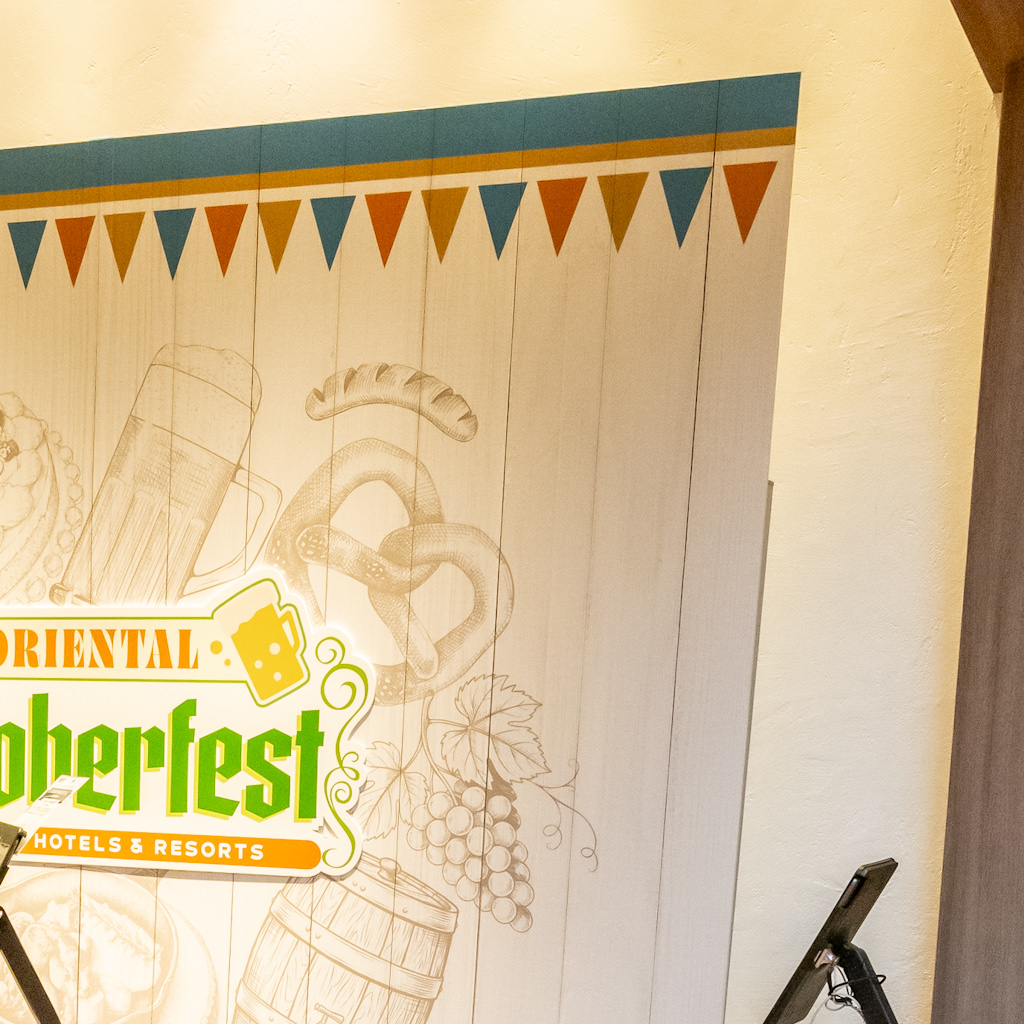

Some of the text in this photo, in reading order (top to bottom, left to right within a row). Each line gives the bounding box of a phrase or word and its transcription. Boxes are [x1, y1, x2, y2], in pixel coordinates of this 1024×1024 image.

[34, 832, 121, 855] HOTELS
[129, 836, 144, 855] &
[155, 838, 265, 861] RESORTS
